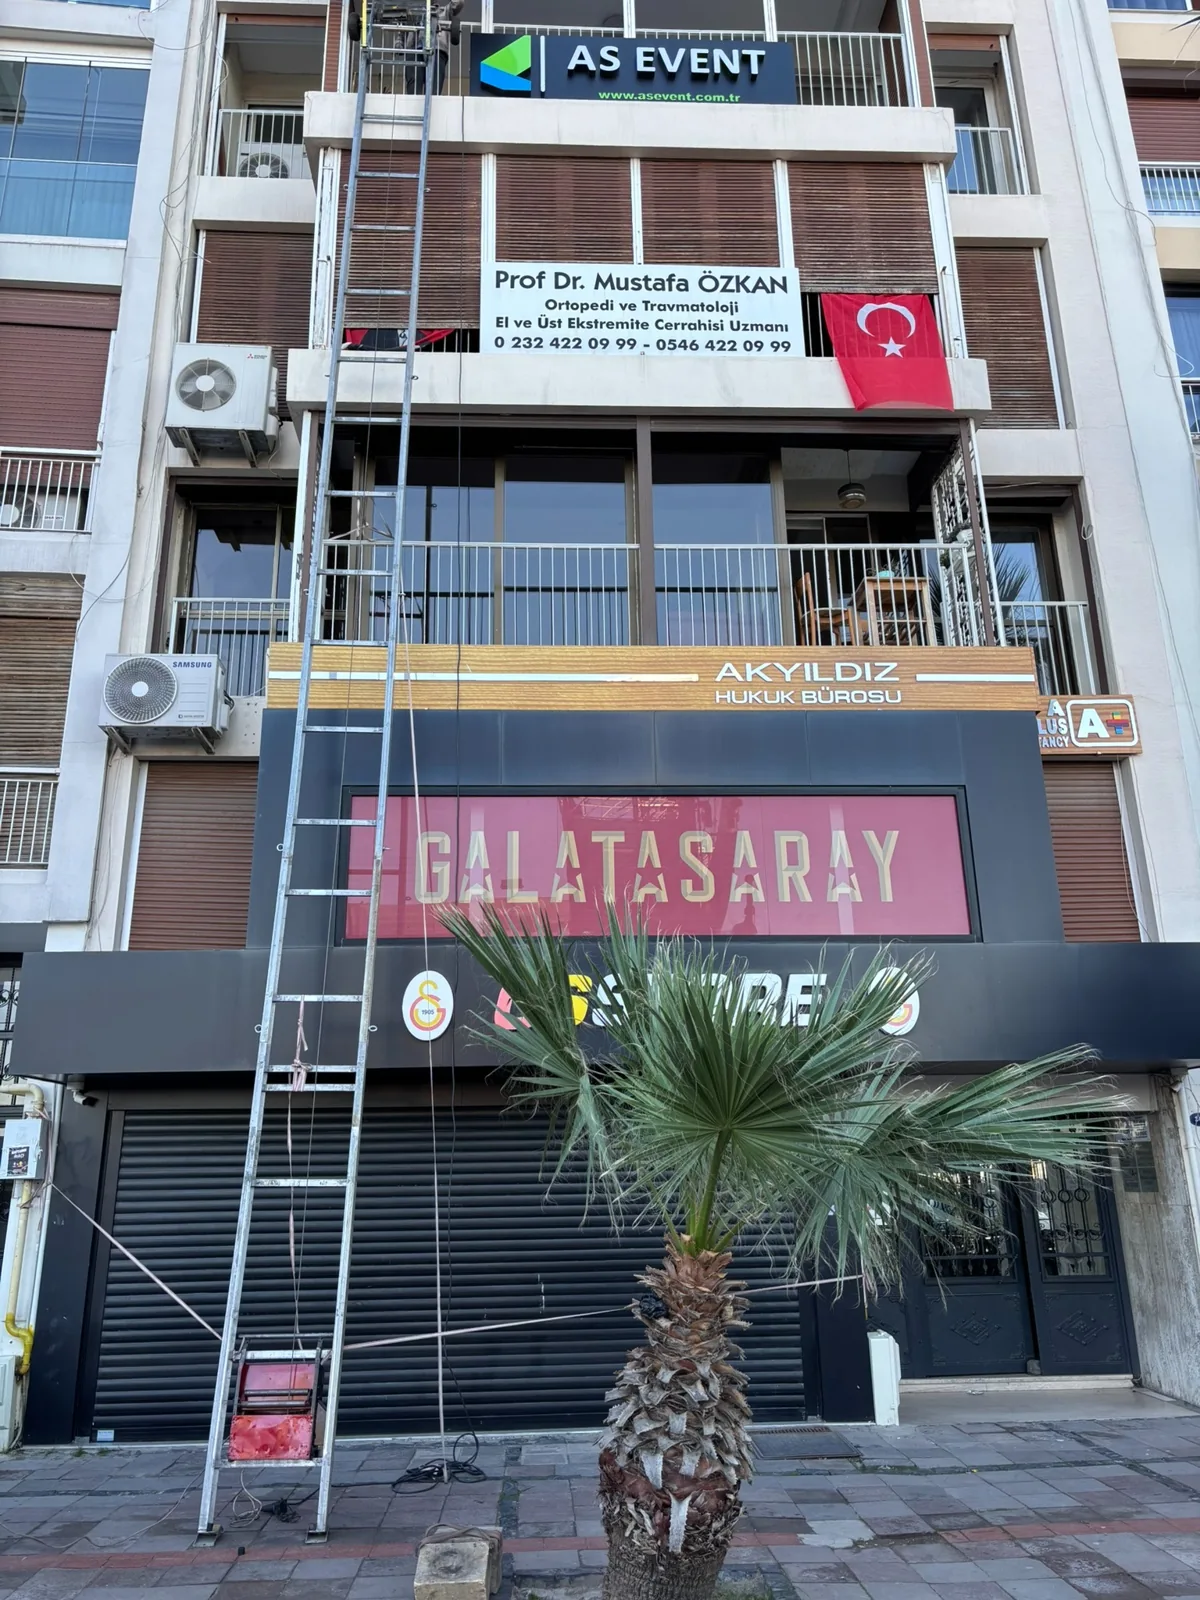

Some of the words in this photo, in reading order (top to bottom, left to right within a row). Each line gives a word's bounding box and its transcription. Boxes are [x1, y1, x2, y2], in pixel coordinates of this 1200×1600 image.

[567, 45, 621, 72] AS
[636, 46, 766, 75] EVENT
[598, 90, 741, 103] www.asevent.com.tr
[495, 270, 546, 289] Prof
[554, 271, 585, 290] Dr.
[593, 272, 690, 292] Mustafa
[698, 270, 788, 294] ÖZKAN
[545, 299, 614, 313] Ortopedi
[619, 302, 637, 311] ve
[642, 300, 739, 316] Travmatoloji
[496, 316, 509, 328] El
[514, 319, 532, 328] ve
[538, 314, 562, 329] Üst
[567, 317, 650, 330] Ekstremite
[654, 318, 724, 332] Cerrahisi
[730, 320, 789, 333] Uzmanı
[494, 336, 505, 348] 0
[511, 336, 544, 349] 232
[549, 337, 582, 349] 422
[588, 337, 610, 350] 09
[615, 338, 637, 350] 99
[656, 339, 700, 351] 0546
[705, 339, 738, 352] 422
[743, 340, 765, 352] 09
[770, 340, 792, 353] 99
[714, 662, 900, 682] AKYILDIZ
[715, 690, 796, 704] HUKUK
[801, 686, 902, 704] BÜROSU
[1047, 698, 1066, 717] A
[413, 829, 901, 905] GALATASARAY
